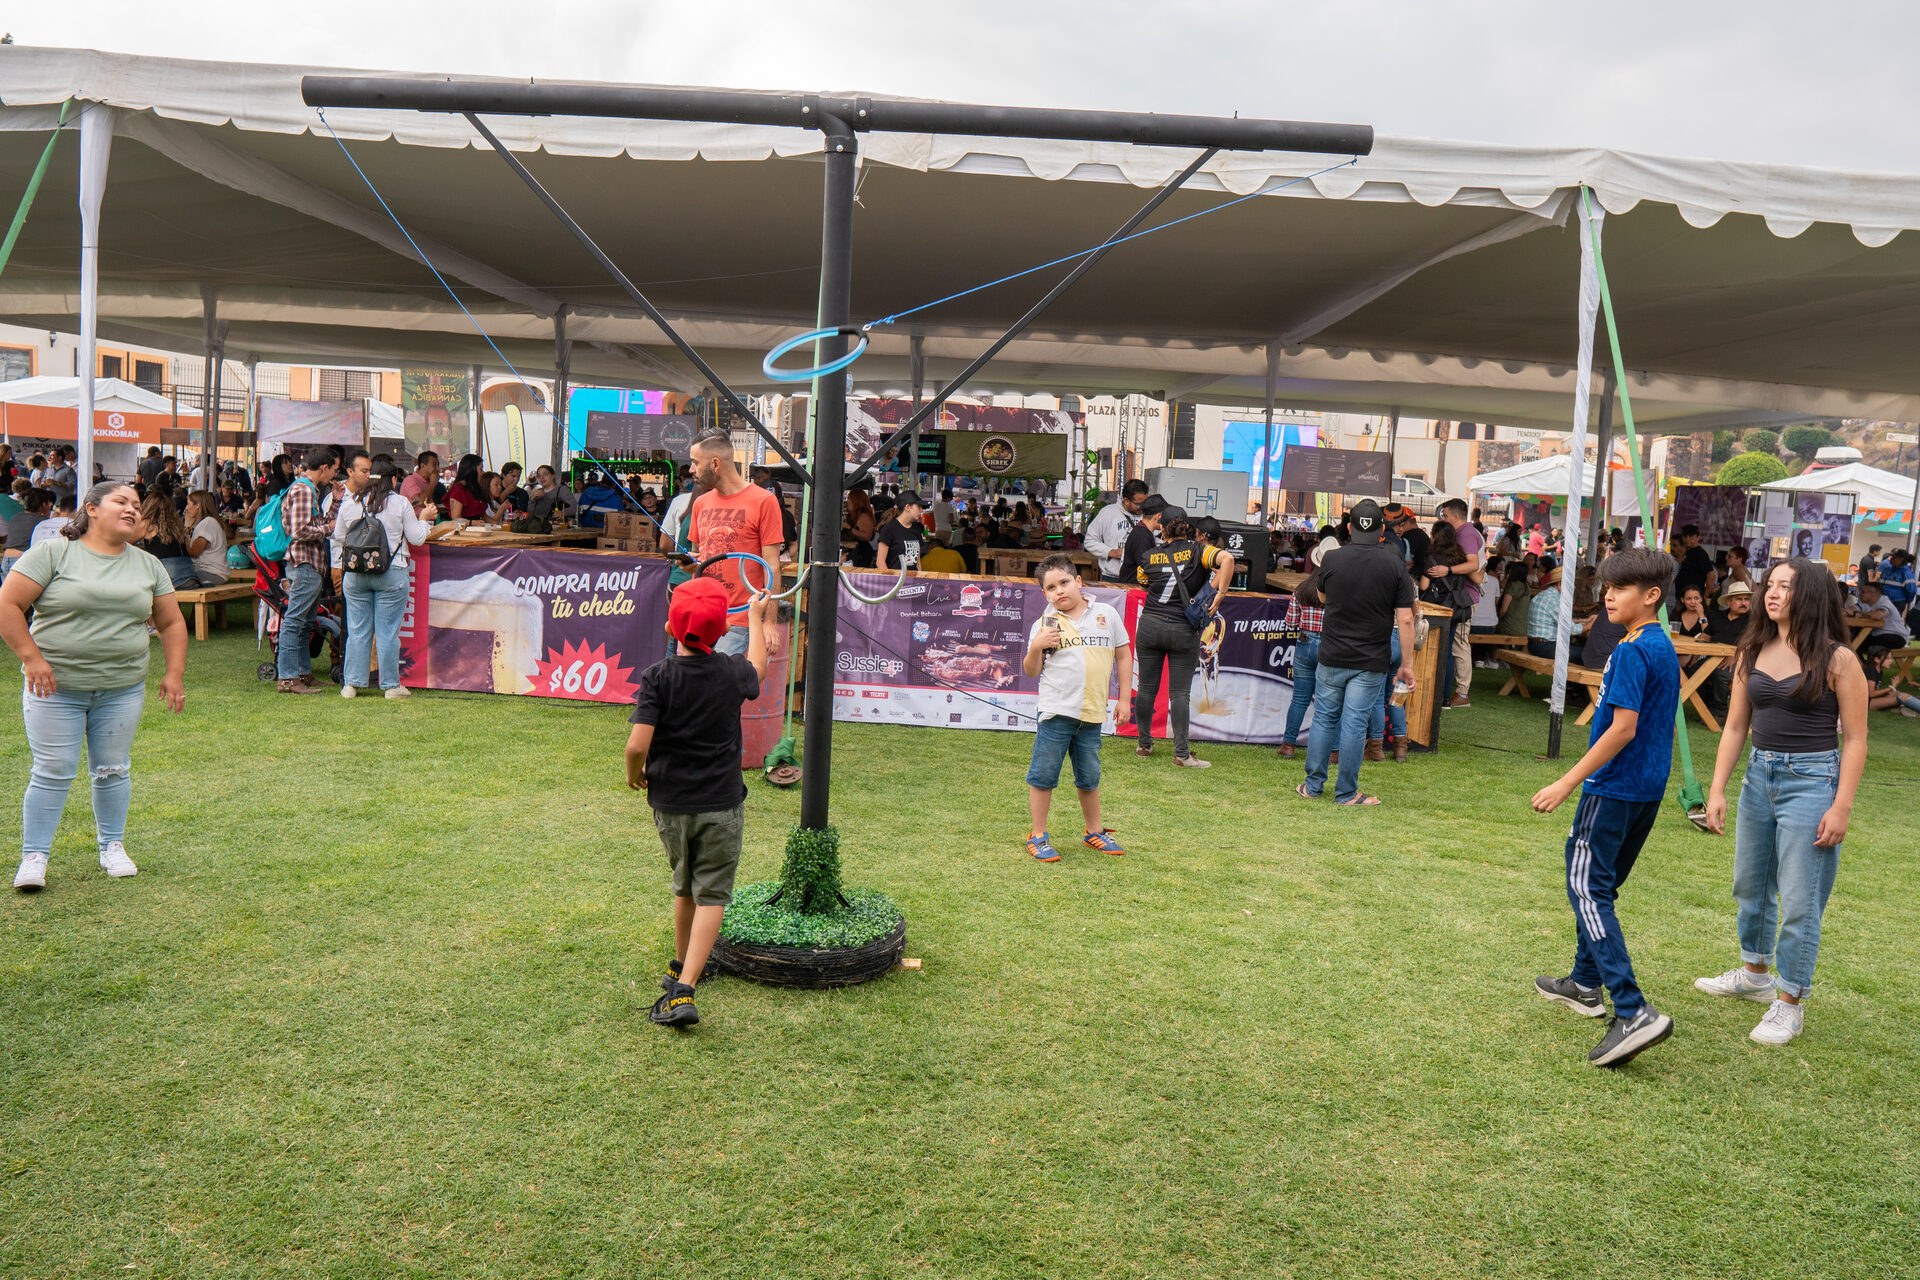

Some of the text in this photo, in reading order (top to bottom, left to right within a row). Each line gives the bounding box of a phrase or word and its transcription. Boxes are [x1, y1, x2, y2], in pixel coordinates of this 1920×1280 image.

[1087, 405, 1116, 416] PLAZA
[93, 429, 139, 438] KIKKOMAN
[700, 508, 746, 524] PIZZA
[514, 565, 642, 597] COMPRA AQUÍ
[551, 591, 635, 619] tu chela
[1233, 620, 1248, 633] TU
[1252, 632, 1266, 640] va
[1267, 632, 1285, 642] por
[549, 660, 608, 696] $60
